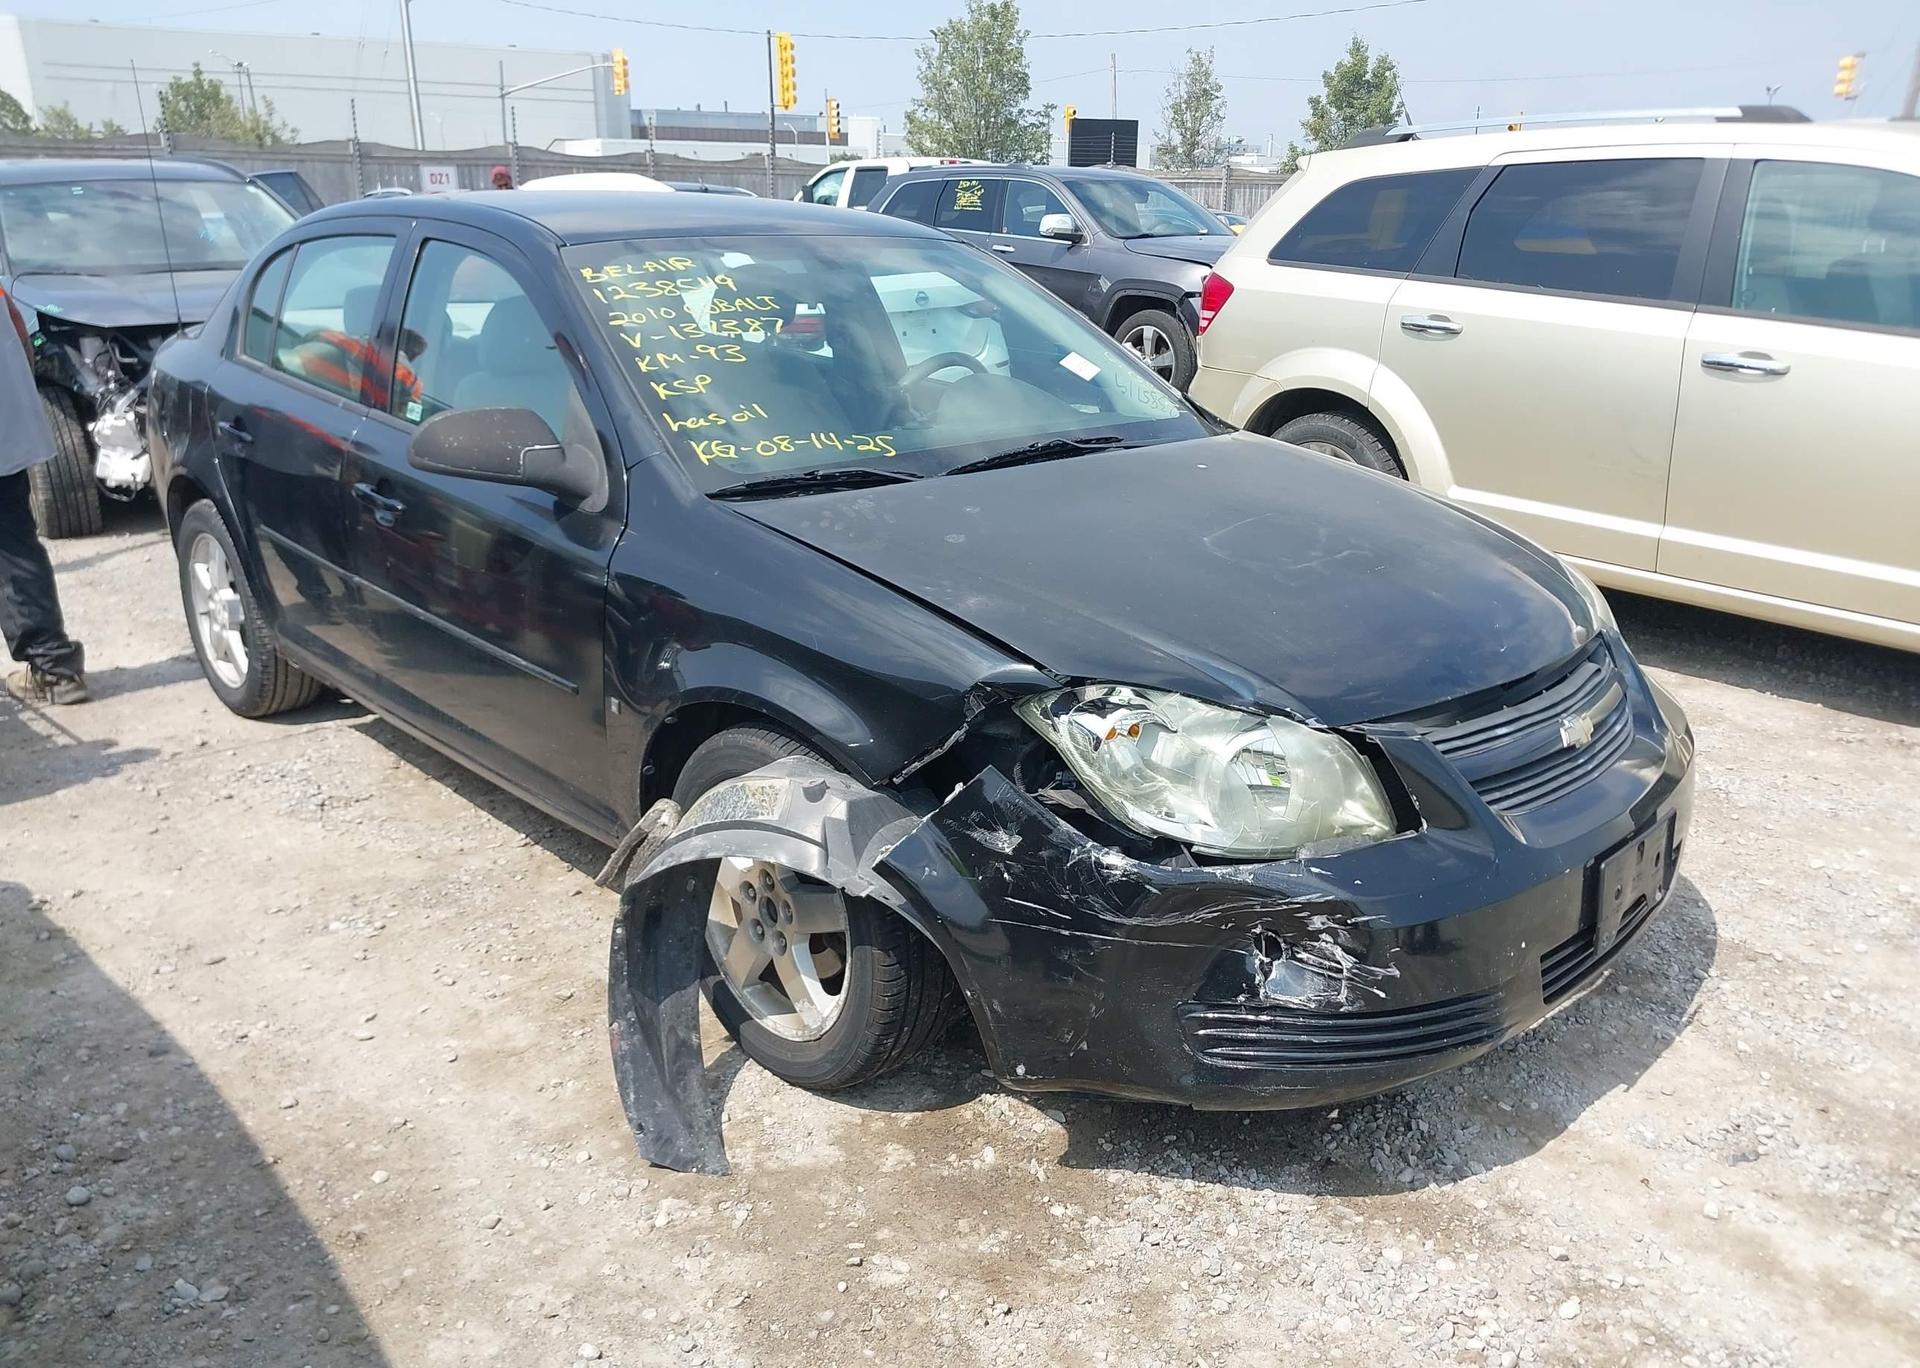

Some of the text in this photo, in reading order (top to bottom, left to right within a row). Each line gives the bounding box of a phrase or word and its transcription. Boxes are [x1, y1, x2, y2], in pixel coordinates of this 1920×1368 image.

[579, 256, 697, 283] BELAIR
[608, 296, 781, 326] 2010 COBALT
[634, 344, 748, 373] KM-93
[650, 374, 712, 400] KSP
